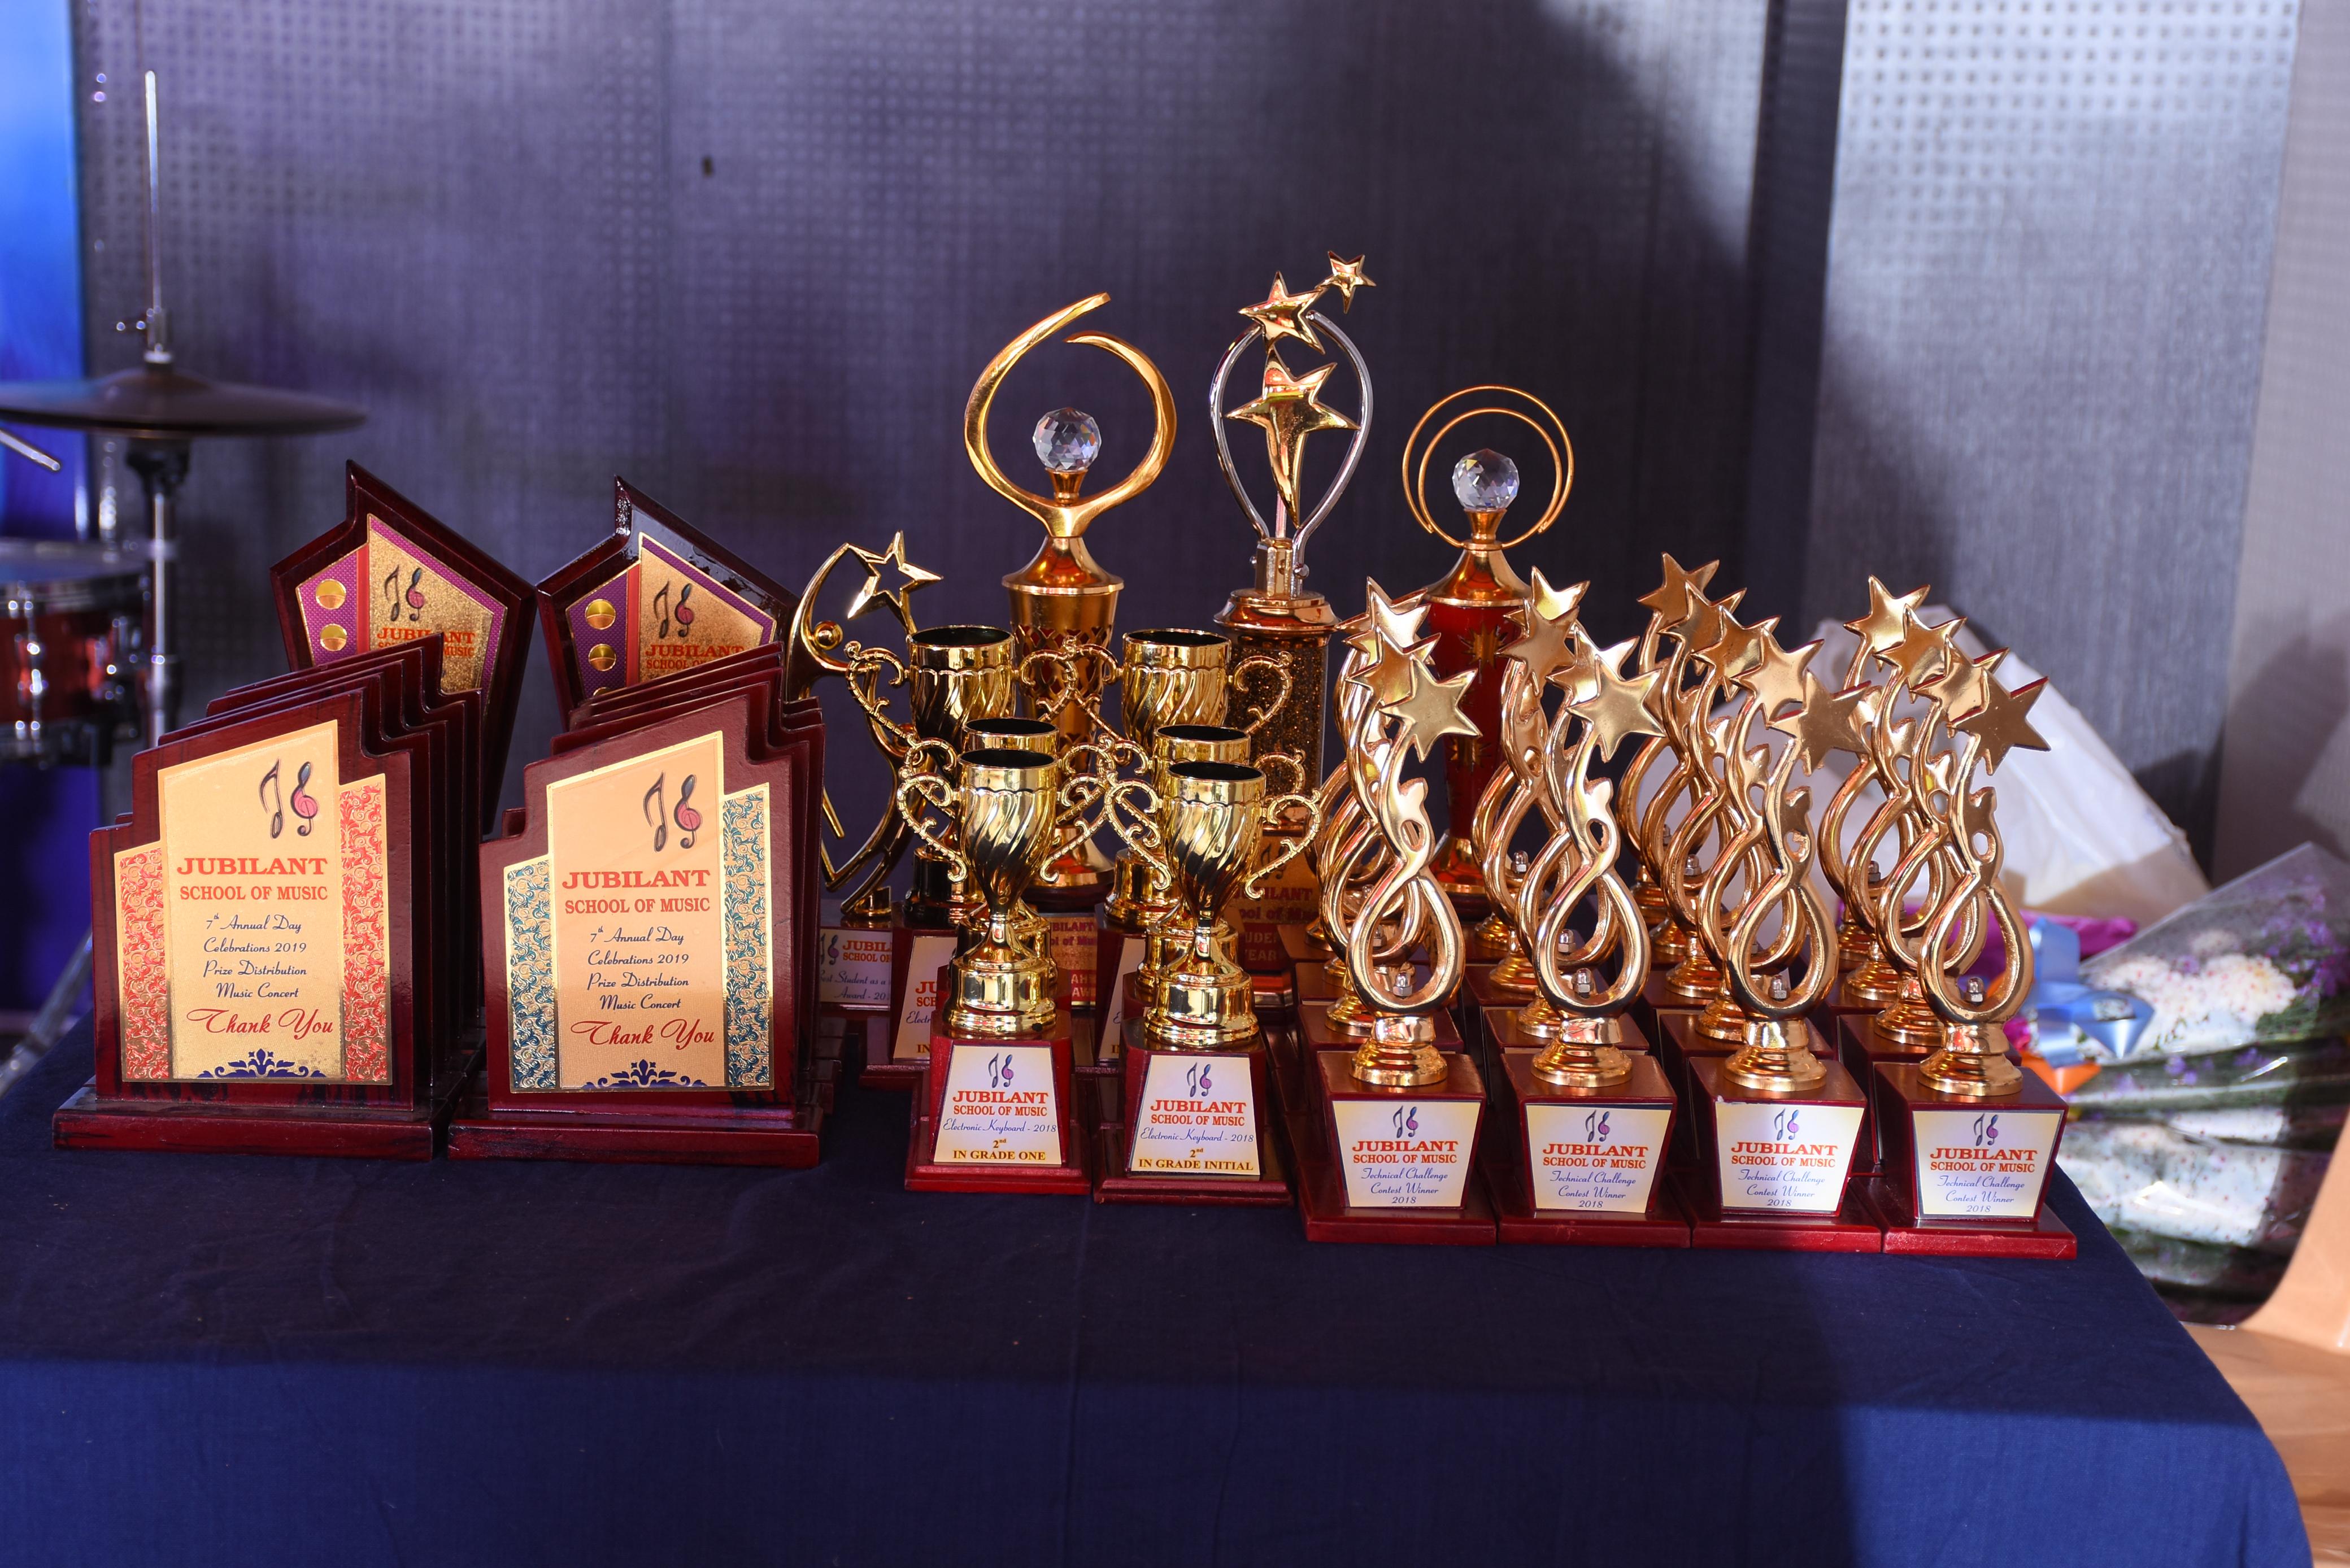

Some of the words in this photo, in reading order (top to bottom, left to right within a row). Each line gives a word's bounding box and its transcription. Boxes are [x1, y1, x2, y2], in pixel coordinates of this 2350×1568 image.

[646, 660, 689, 669] SCHOOL
[177, 858, 328, 874] JUBILANT
[562, 870, 711, 888] JUBILANT
[180, 886, 245, 900] SCHOOL
[251, 886, 272, 900] OF
[277, 886, 328, 900] MUSIC
[565, 899, 629, 914] SCHOOL
[634, 899, 655, 912] OF
[661, 898, 710, 912] MUSIC
[220, 914, 271, 930] Annual
[272, 914, 302, 934] Day
[604, 927, 654, 942] Annual
[655, 926, 685, 945] Day
[203, 937, 270, 952] Celebrations
[275, 943, 306, 952] 2019
[588, 949, 653, 965] Celebrations
[657, 954, 689, 964] 2019
[843, 952, 877, 961] SCHOOL
[203, 960, 233, 977] Prize
[238, 960, 307, 975] Distribution
[588, 973, 616, 990] Prize
[621, 972, 689, 987] Distribution
[835, 971, 868, 984] Student
[216, 983, 253, 998] Music
[258, 982, 299, 998] Concert
[834, 986, 867, 999] Award
[599, 995, 636, 1010] Music
[641, 994, 681, 1009] Concert
[186, 1008, 271, 1033] Thank
[278, 1008, 333, 1040] You
[571, 1021, 654, 1045] Thank
[661, 1018, 715, 1050] You
[952, 1091, 1048, 1103] JUBILANT
[954, 1105, 995, 1115] SCHOOL
[998, 1106, 1012, 1116] OF
[1015, 1107, 1047, 1116] MUSIC
[1150, 1100, 1246, 1113] JUBILANT
[943, 1118, 982, 1131] Electronic
[982, 1119, 1026, 1134] Keyboard
[1151, 1114, 1193, 1125] SCHOOL
[1196, 1116, 1209, 1125] OF
[1212, 1116, 1245, 1126] MUSIC
[1140, 1127, 1178, 1140] Electronic
[1180, 1129, 1224, 1144] Keyboard
[1352, 1141, 1459, 1152] JUBILANT
[1543, 1144, 1648, 1157] JUBILANT
[1731, 1142, 1838, 1156] JUBILANT
[971, 1151, 1015, 1160] GRADE
[1019, 1152, 1045, 1160] ONE
[1354, 1155, 1399, 1164] SCHOOL
[1403, 1155, 1417, 1163] OF
[1421, 1155, 1457, 1164] MUSIC
[1930, 1148, 2038, 1161] JUBILANT
[1156, 1160, 1200, 1169] GRADE
[1204, 1161, 1254, 1170] INITIAL
[1543, 1157, 1589, 1167] SCHOOL
[1592, 1158, 1607, 1168] OF
[1611, 1160, 1646, 1169] MUSIC
[1731, 1155, 1777, 1165] SCHOOL
[1781, 1157, 1795, 1166] OF
[1800, 1158, 1835, 1168] MUSIC
[1930, 1162, 1977, 1171] SCHOOL
[1980, 1162, 1995, 1171] OF
[1999, 1164, 2035, 1173] MUSIC
[1361, 1168, 1405, 1179] Technical
[1405, 1168, 1448, 1182] Challenge
[1550, 1171, 1594, 1183] Technical
[1594, 1171, 1636, 1186] Challenge
[1738, 1169, 1782, 1181] Technical
[1783, 1170, 1825, 1186] Challenge
[1370, 1182, 1402, 1194] Contest
[1406, 1183, 1438, 1194] Winner
[1937, 1175, 1982, 1187] Technical
[1982, 1176, 2025, 1191] Challenge
[1559, 1186, 1589, 1197] Contest
[1594, 1187, 1626, 1199] Winner
[1747, 1184, 1778, 1196] Contest
[1782, 1186, 1815, 1197] Winner
[1946, 1190, 1977, 1202] Contest
[1982, 1191, 2014, 1203] Winner
